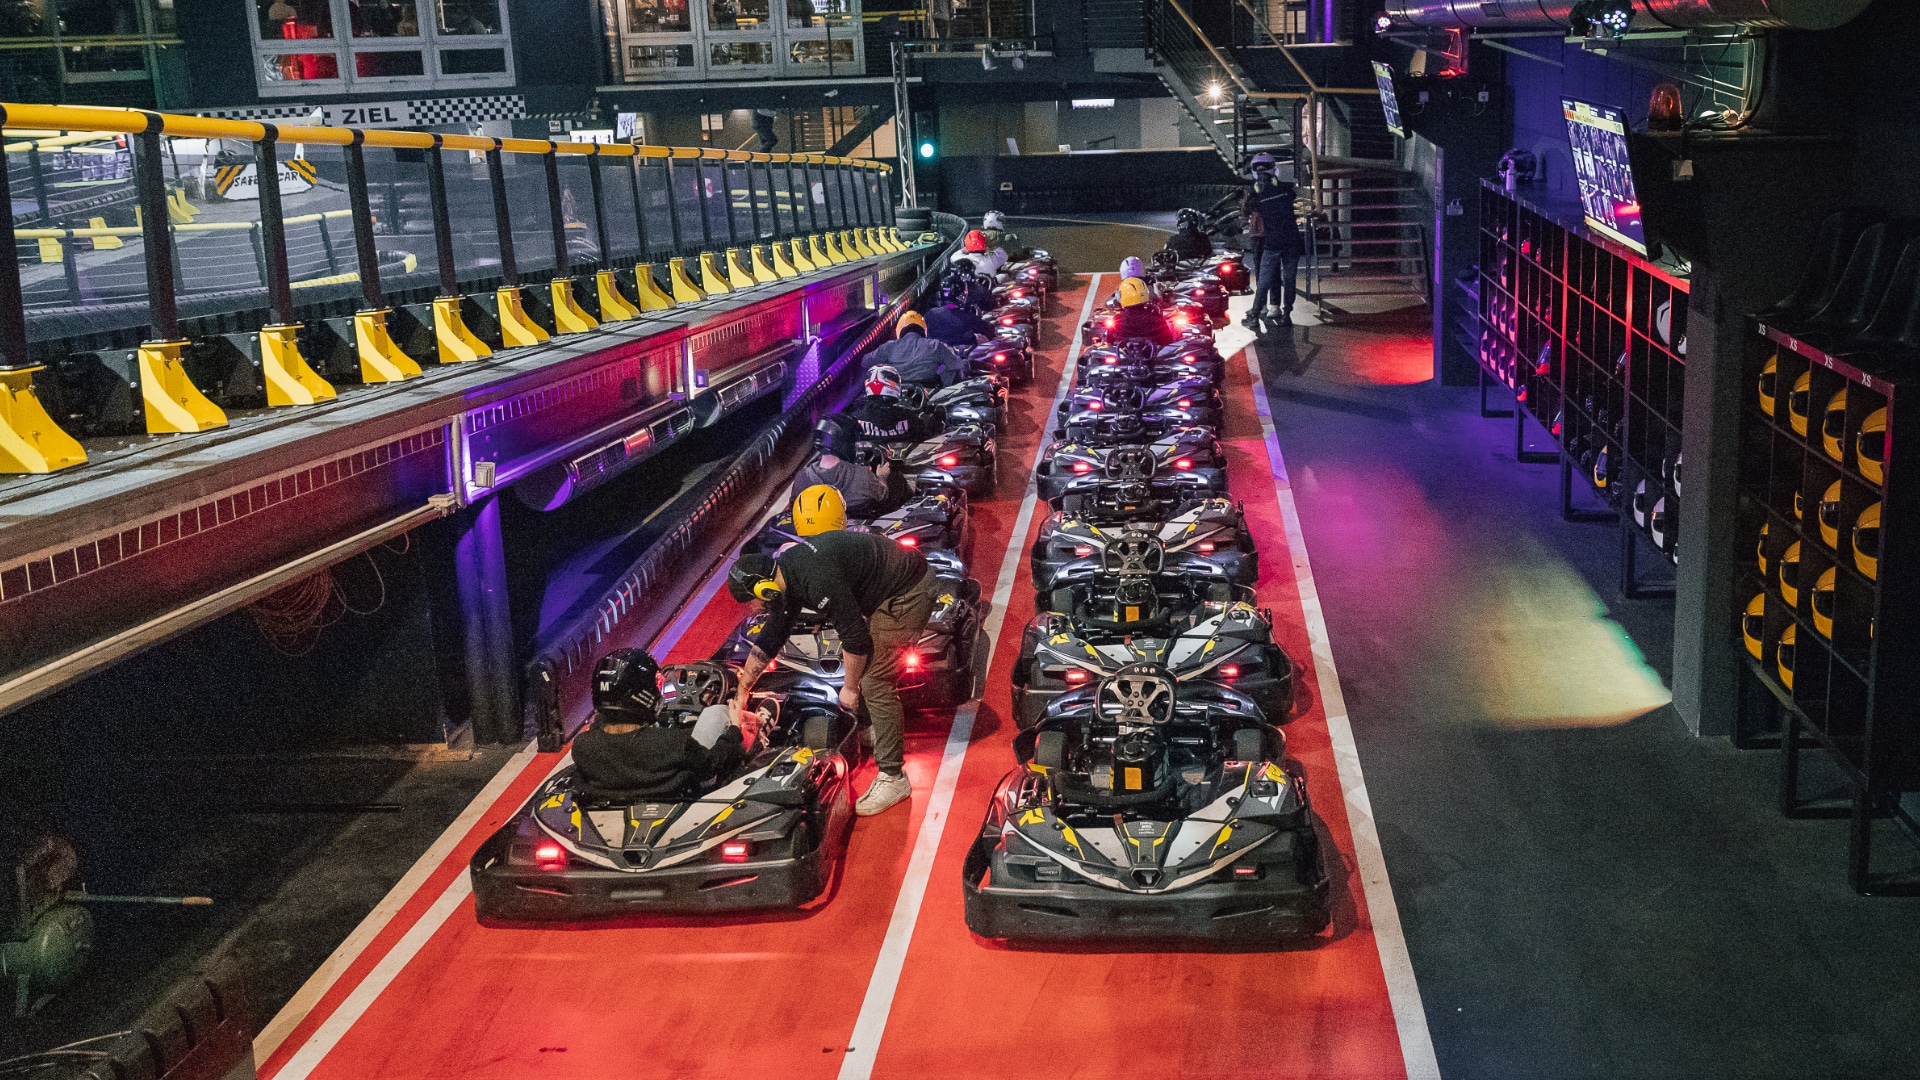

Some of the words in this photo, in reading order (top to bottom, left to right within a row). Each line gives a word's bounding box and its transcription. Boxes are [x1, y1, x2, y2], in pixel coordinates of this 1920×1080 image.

[342, 107, 398, 125] ZIEL
[234, 175, 259, 187] SAFE
[1758, 322, 1766, 335] XS
[1789, 337, 1798, 351] XS
[1824, 354, 1833, 369] XS
[1861, 372, 1871, 387] XS
[600, 681, 610, 691] M
